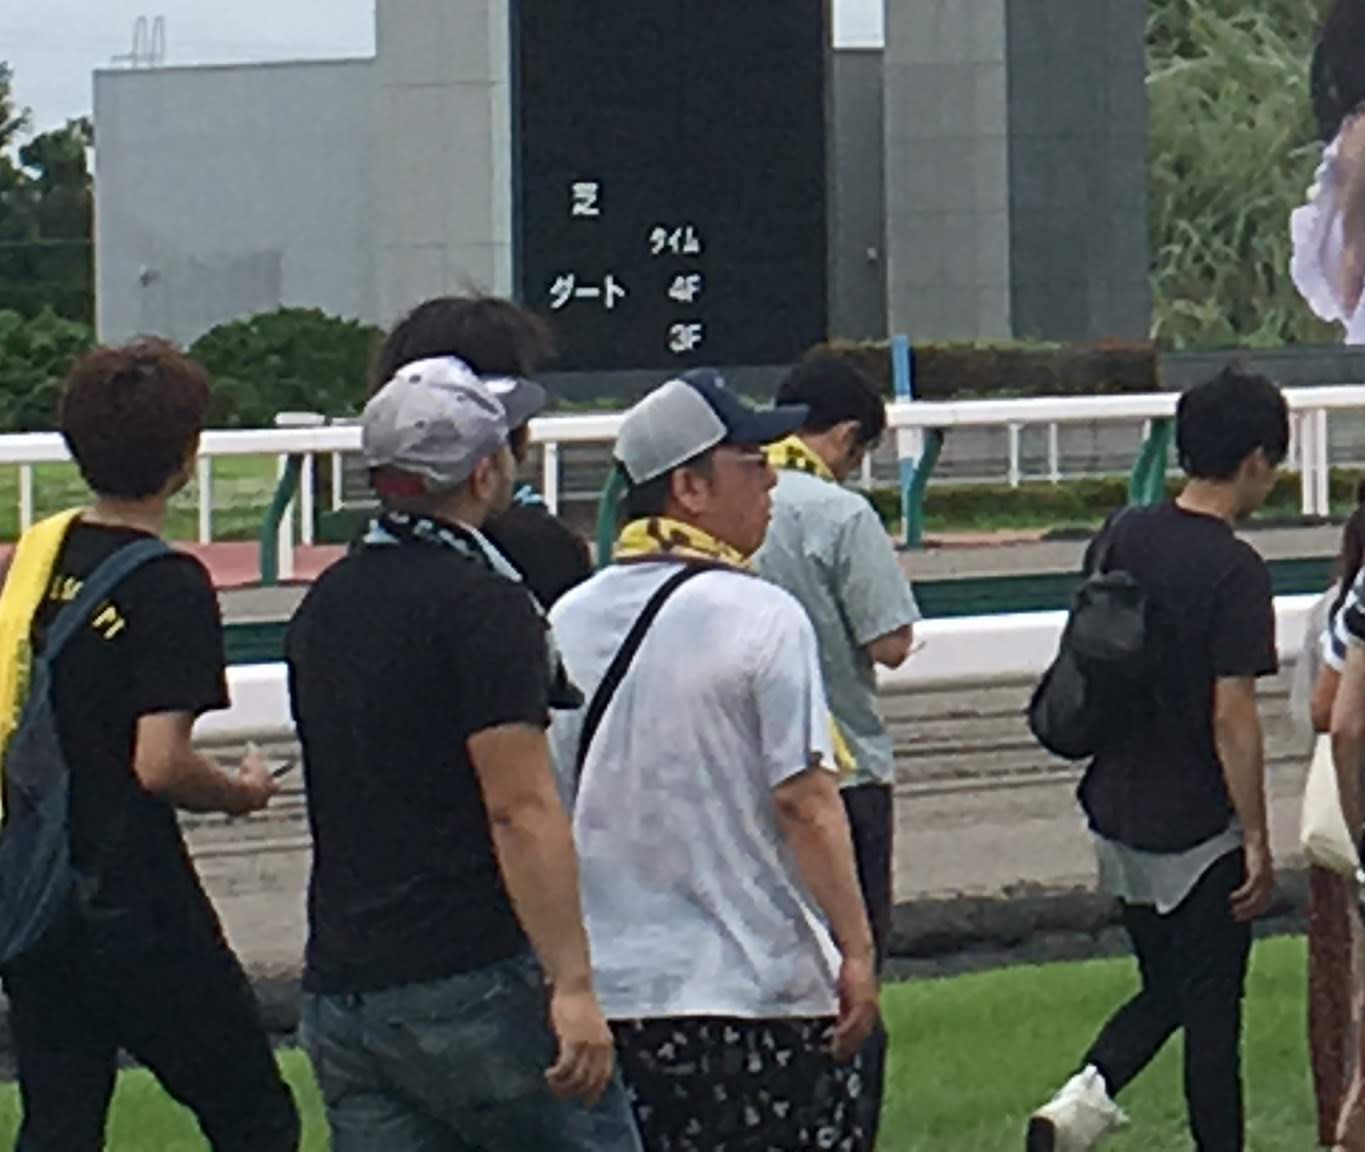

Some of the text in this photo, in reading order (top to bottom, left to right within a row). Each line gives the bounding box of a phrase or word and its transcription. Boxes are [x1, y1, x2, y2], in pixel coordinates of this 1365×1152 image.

[650, 226, 700, 254] タイム
[550, 273, 626, 309] ダート
[668, 274, 701, 303] 4F
[669, 323, 702, 352] 3F
